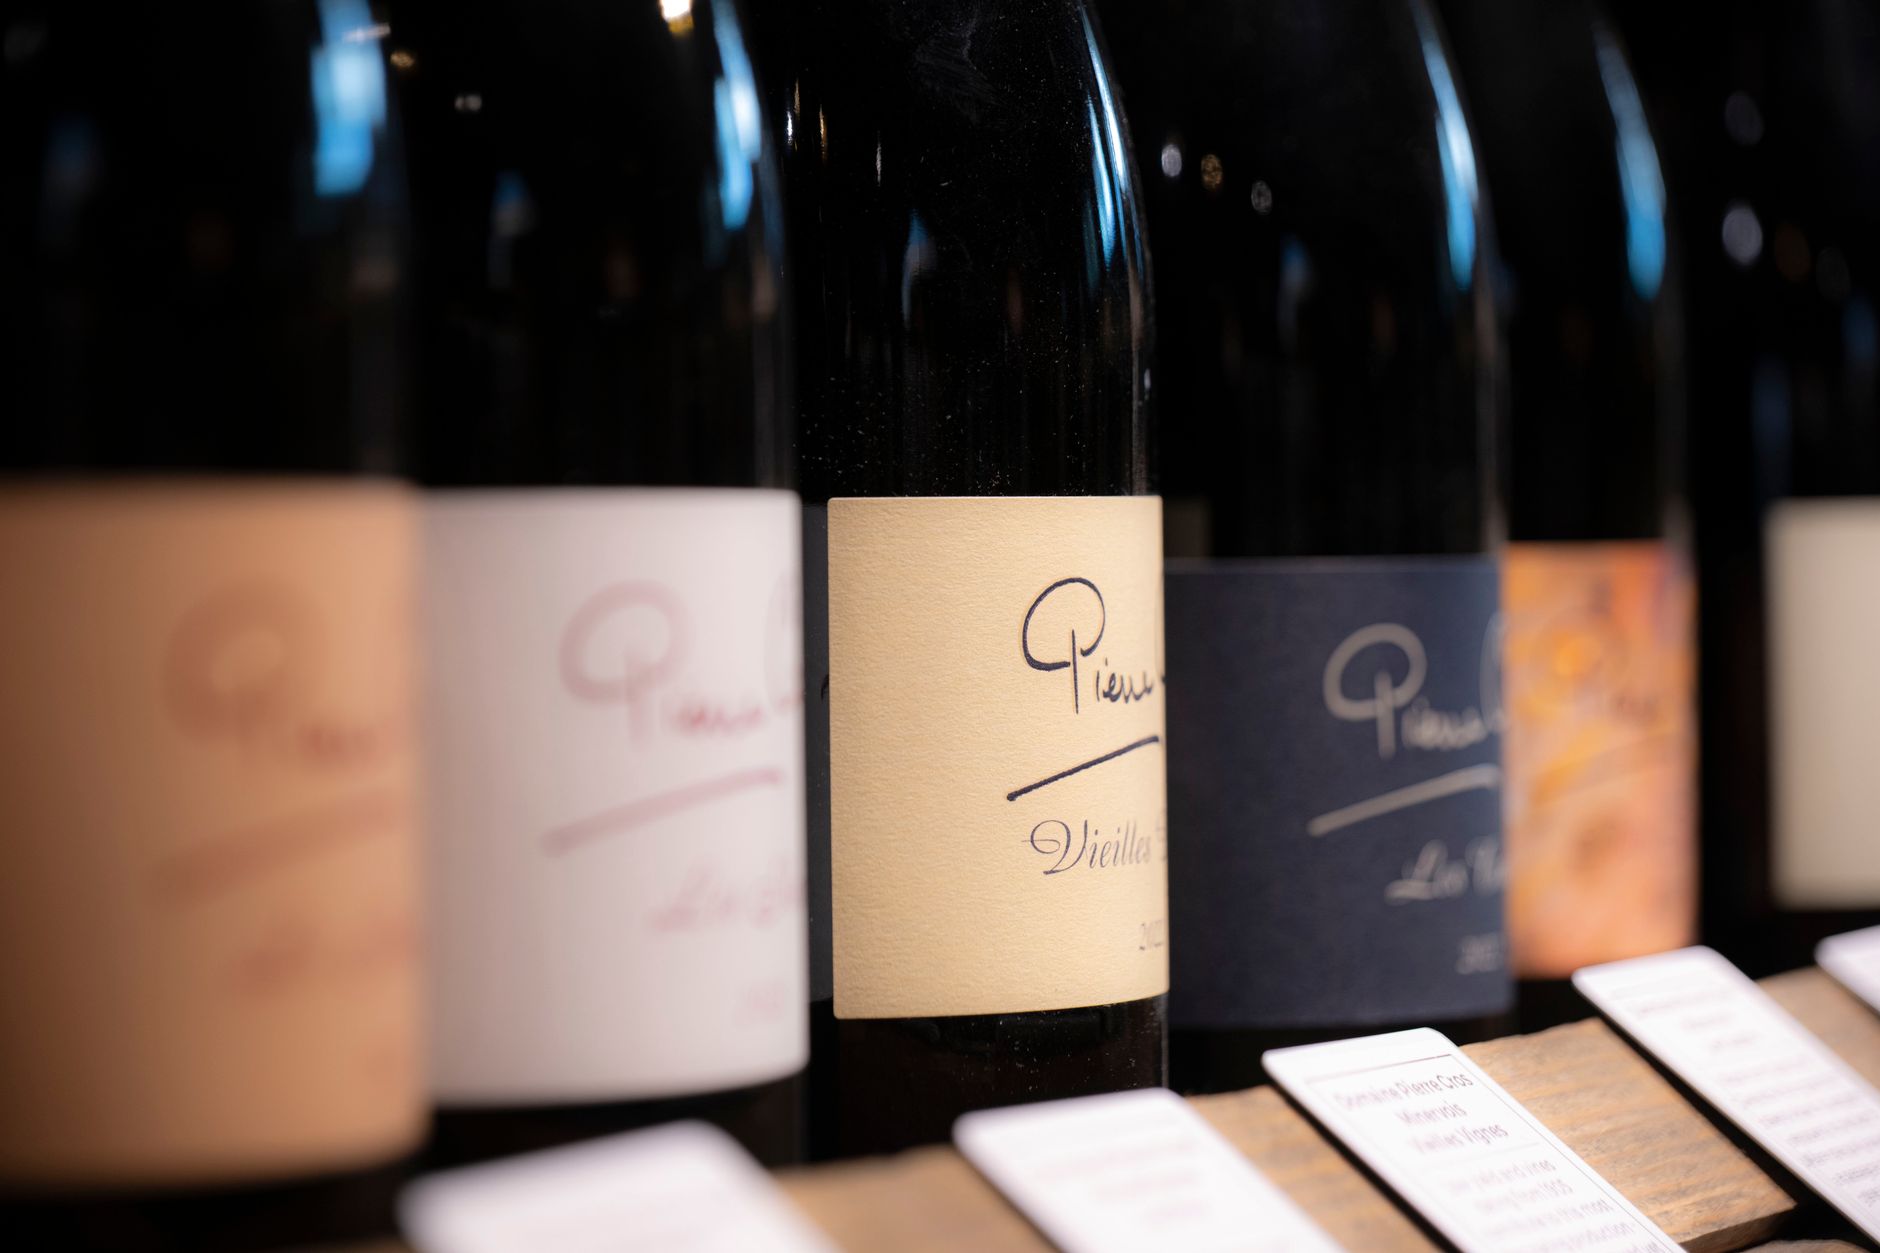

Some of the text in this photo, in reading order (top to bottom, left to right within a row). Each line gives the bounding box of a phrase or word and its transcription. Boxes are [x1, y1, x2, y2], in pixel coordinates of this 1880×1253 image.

[1022, 819, 1152, 876] Vieilles
[1395, 1079, 1443, 1100] Pierre
[1436, 1073, 1474, 1091] Cros
[1458, 1123, 1510, 1145] Vignes
